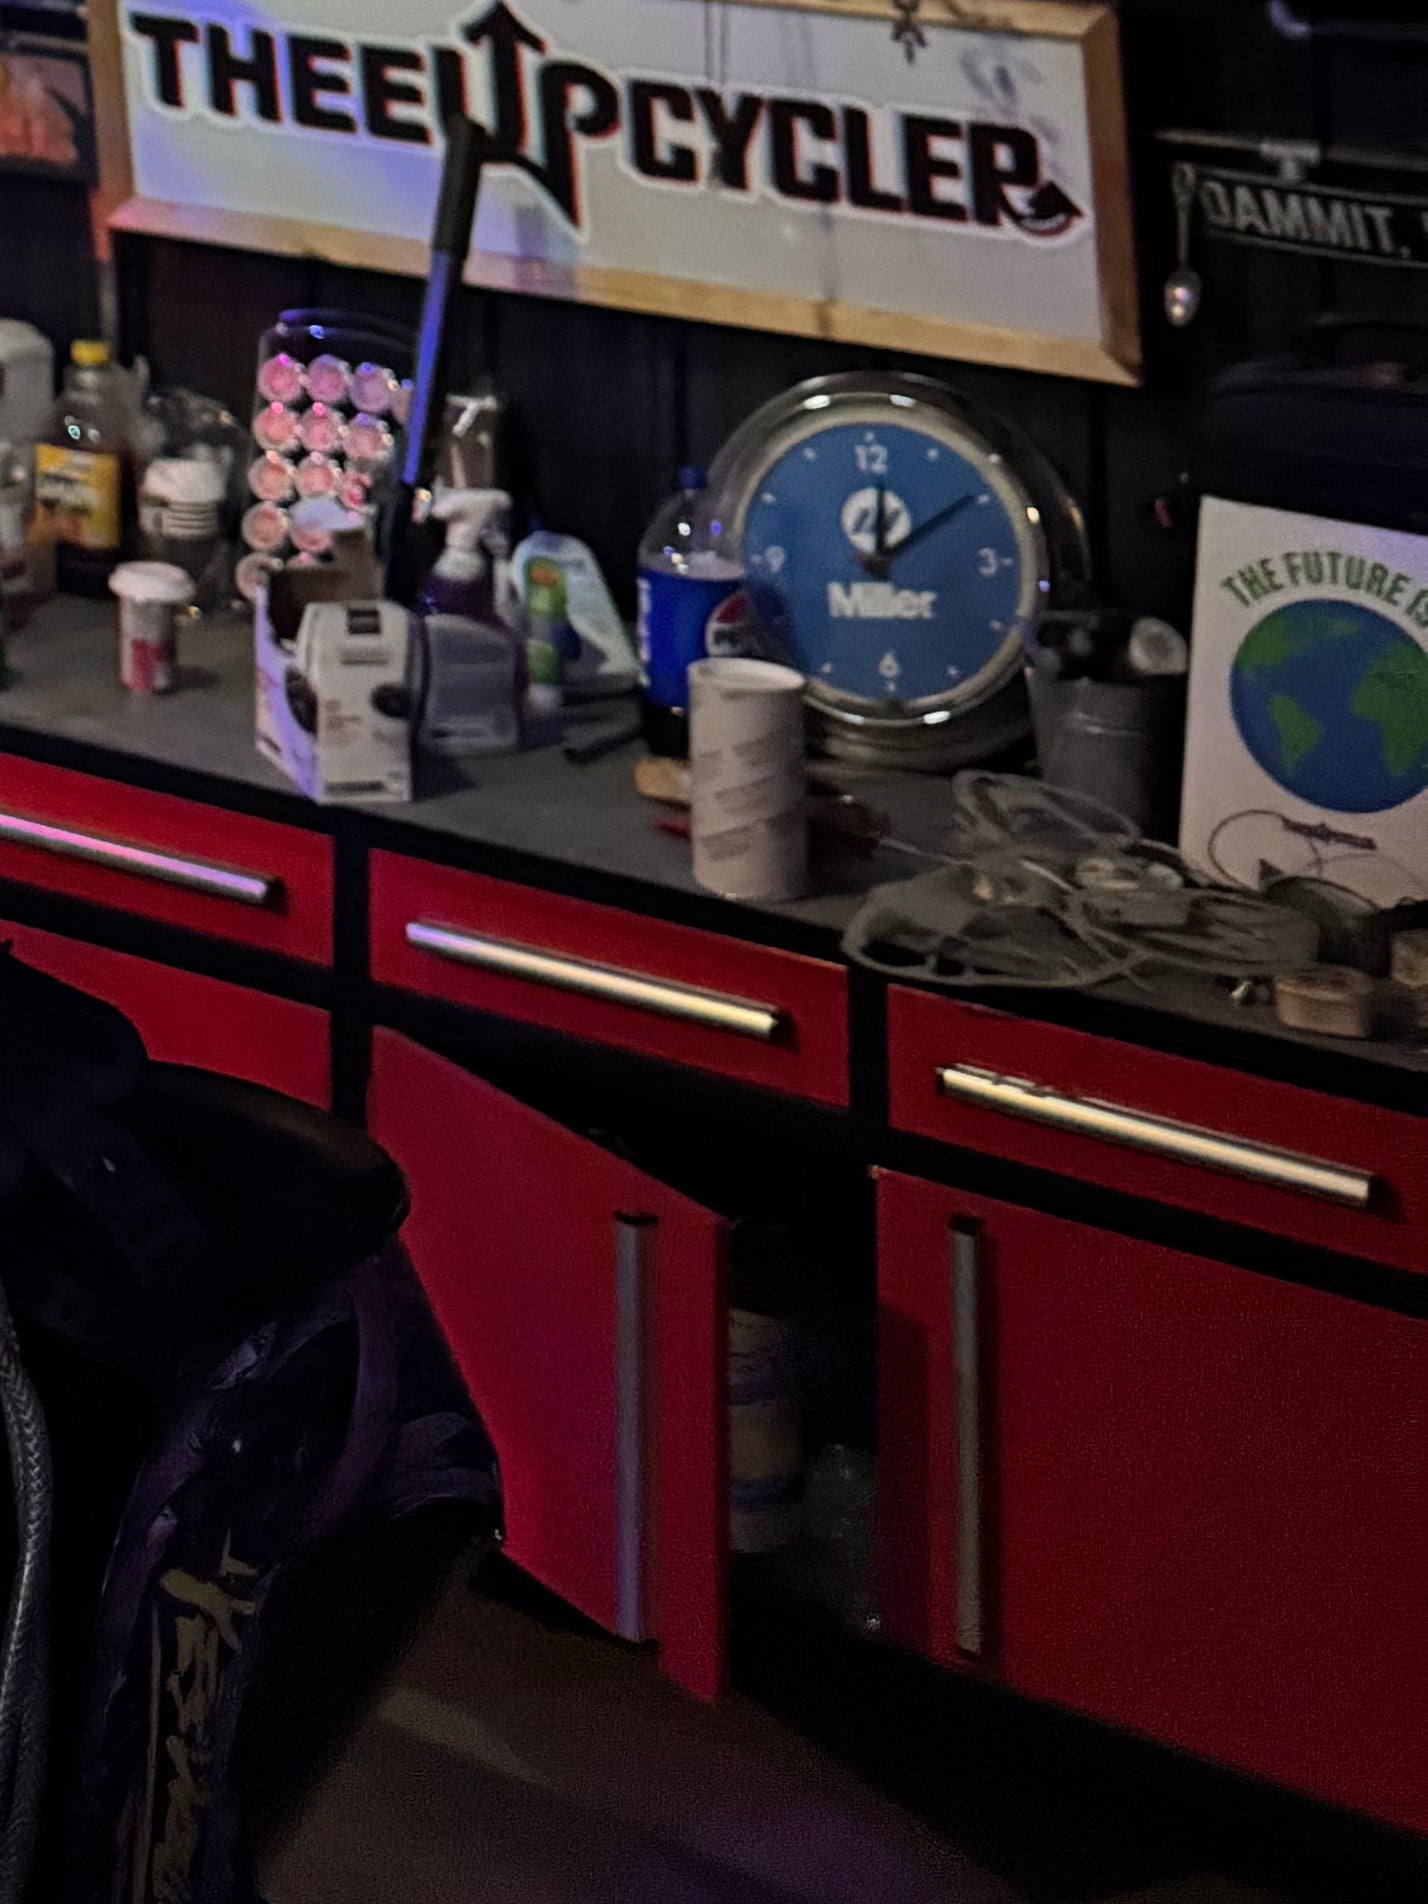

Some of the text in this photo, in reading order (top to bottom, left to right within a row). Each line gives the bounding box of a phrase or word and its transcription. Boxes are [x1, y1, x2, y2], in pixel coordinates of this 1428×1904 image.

[854, 444, 887, 473] 12
[764, 545, 785, 572] 9
[978, 547, 998, 576] 3
[1220, 558, 1285, 608] THE
[1282, 551, 1411, 606] FUTURE
[827, 581, 937, 620] Miller
[879, 651, 900, 677] 6
